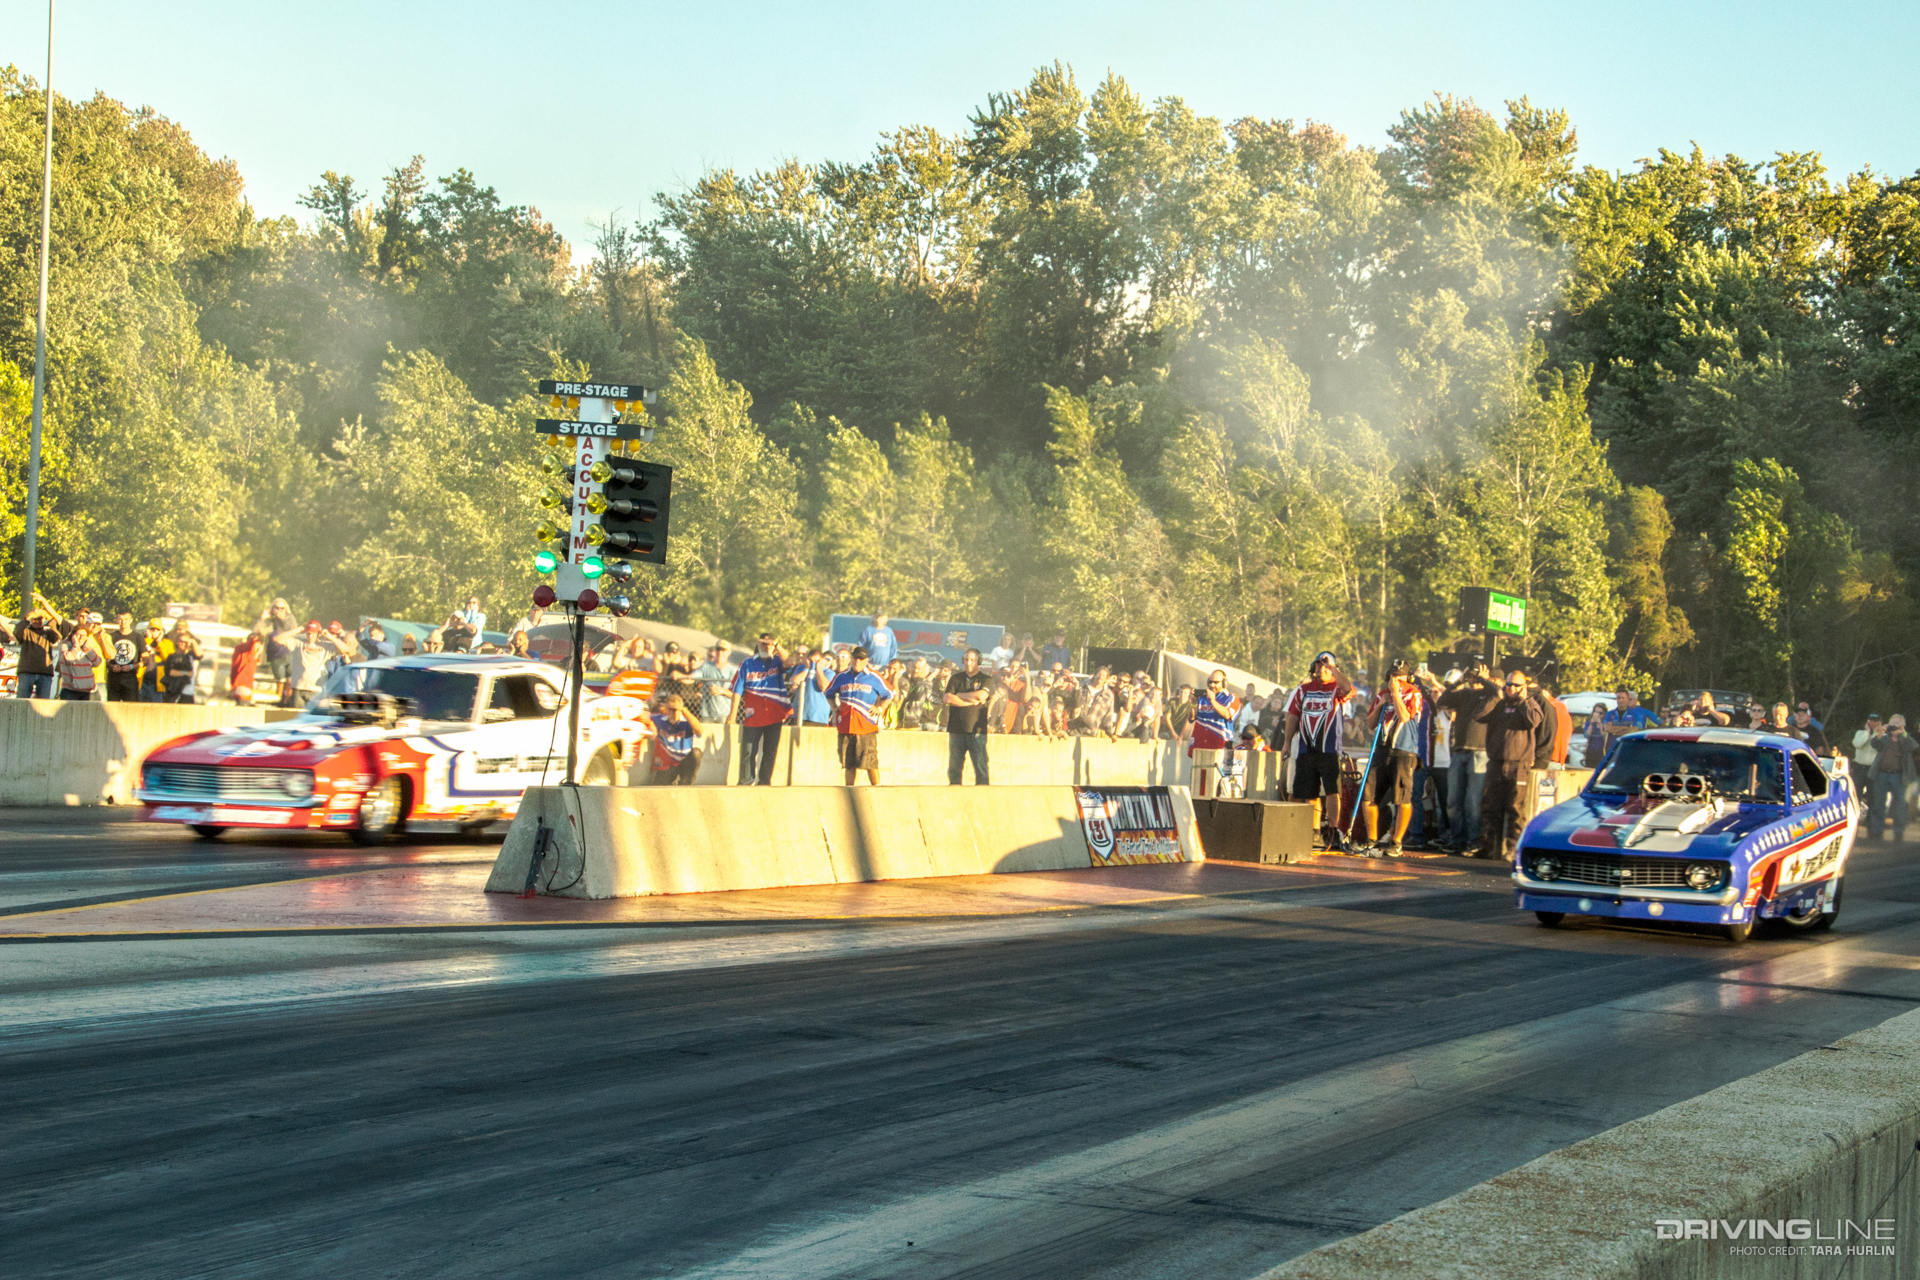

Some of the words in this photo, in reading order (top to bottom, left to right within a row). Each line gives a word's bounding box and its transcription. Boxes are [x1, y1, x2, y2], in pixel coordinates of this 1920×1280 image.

[555, 382, 629, 398] PRE-STAGE
[559, 422, 618, 436] STAGE
[574, 436, 594, 564] ACCUTIME
[1156, 795, 1174, 828] MI
[1612, 869, 1632, 877] SS
